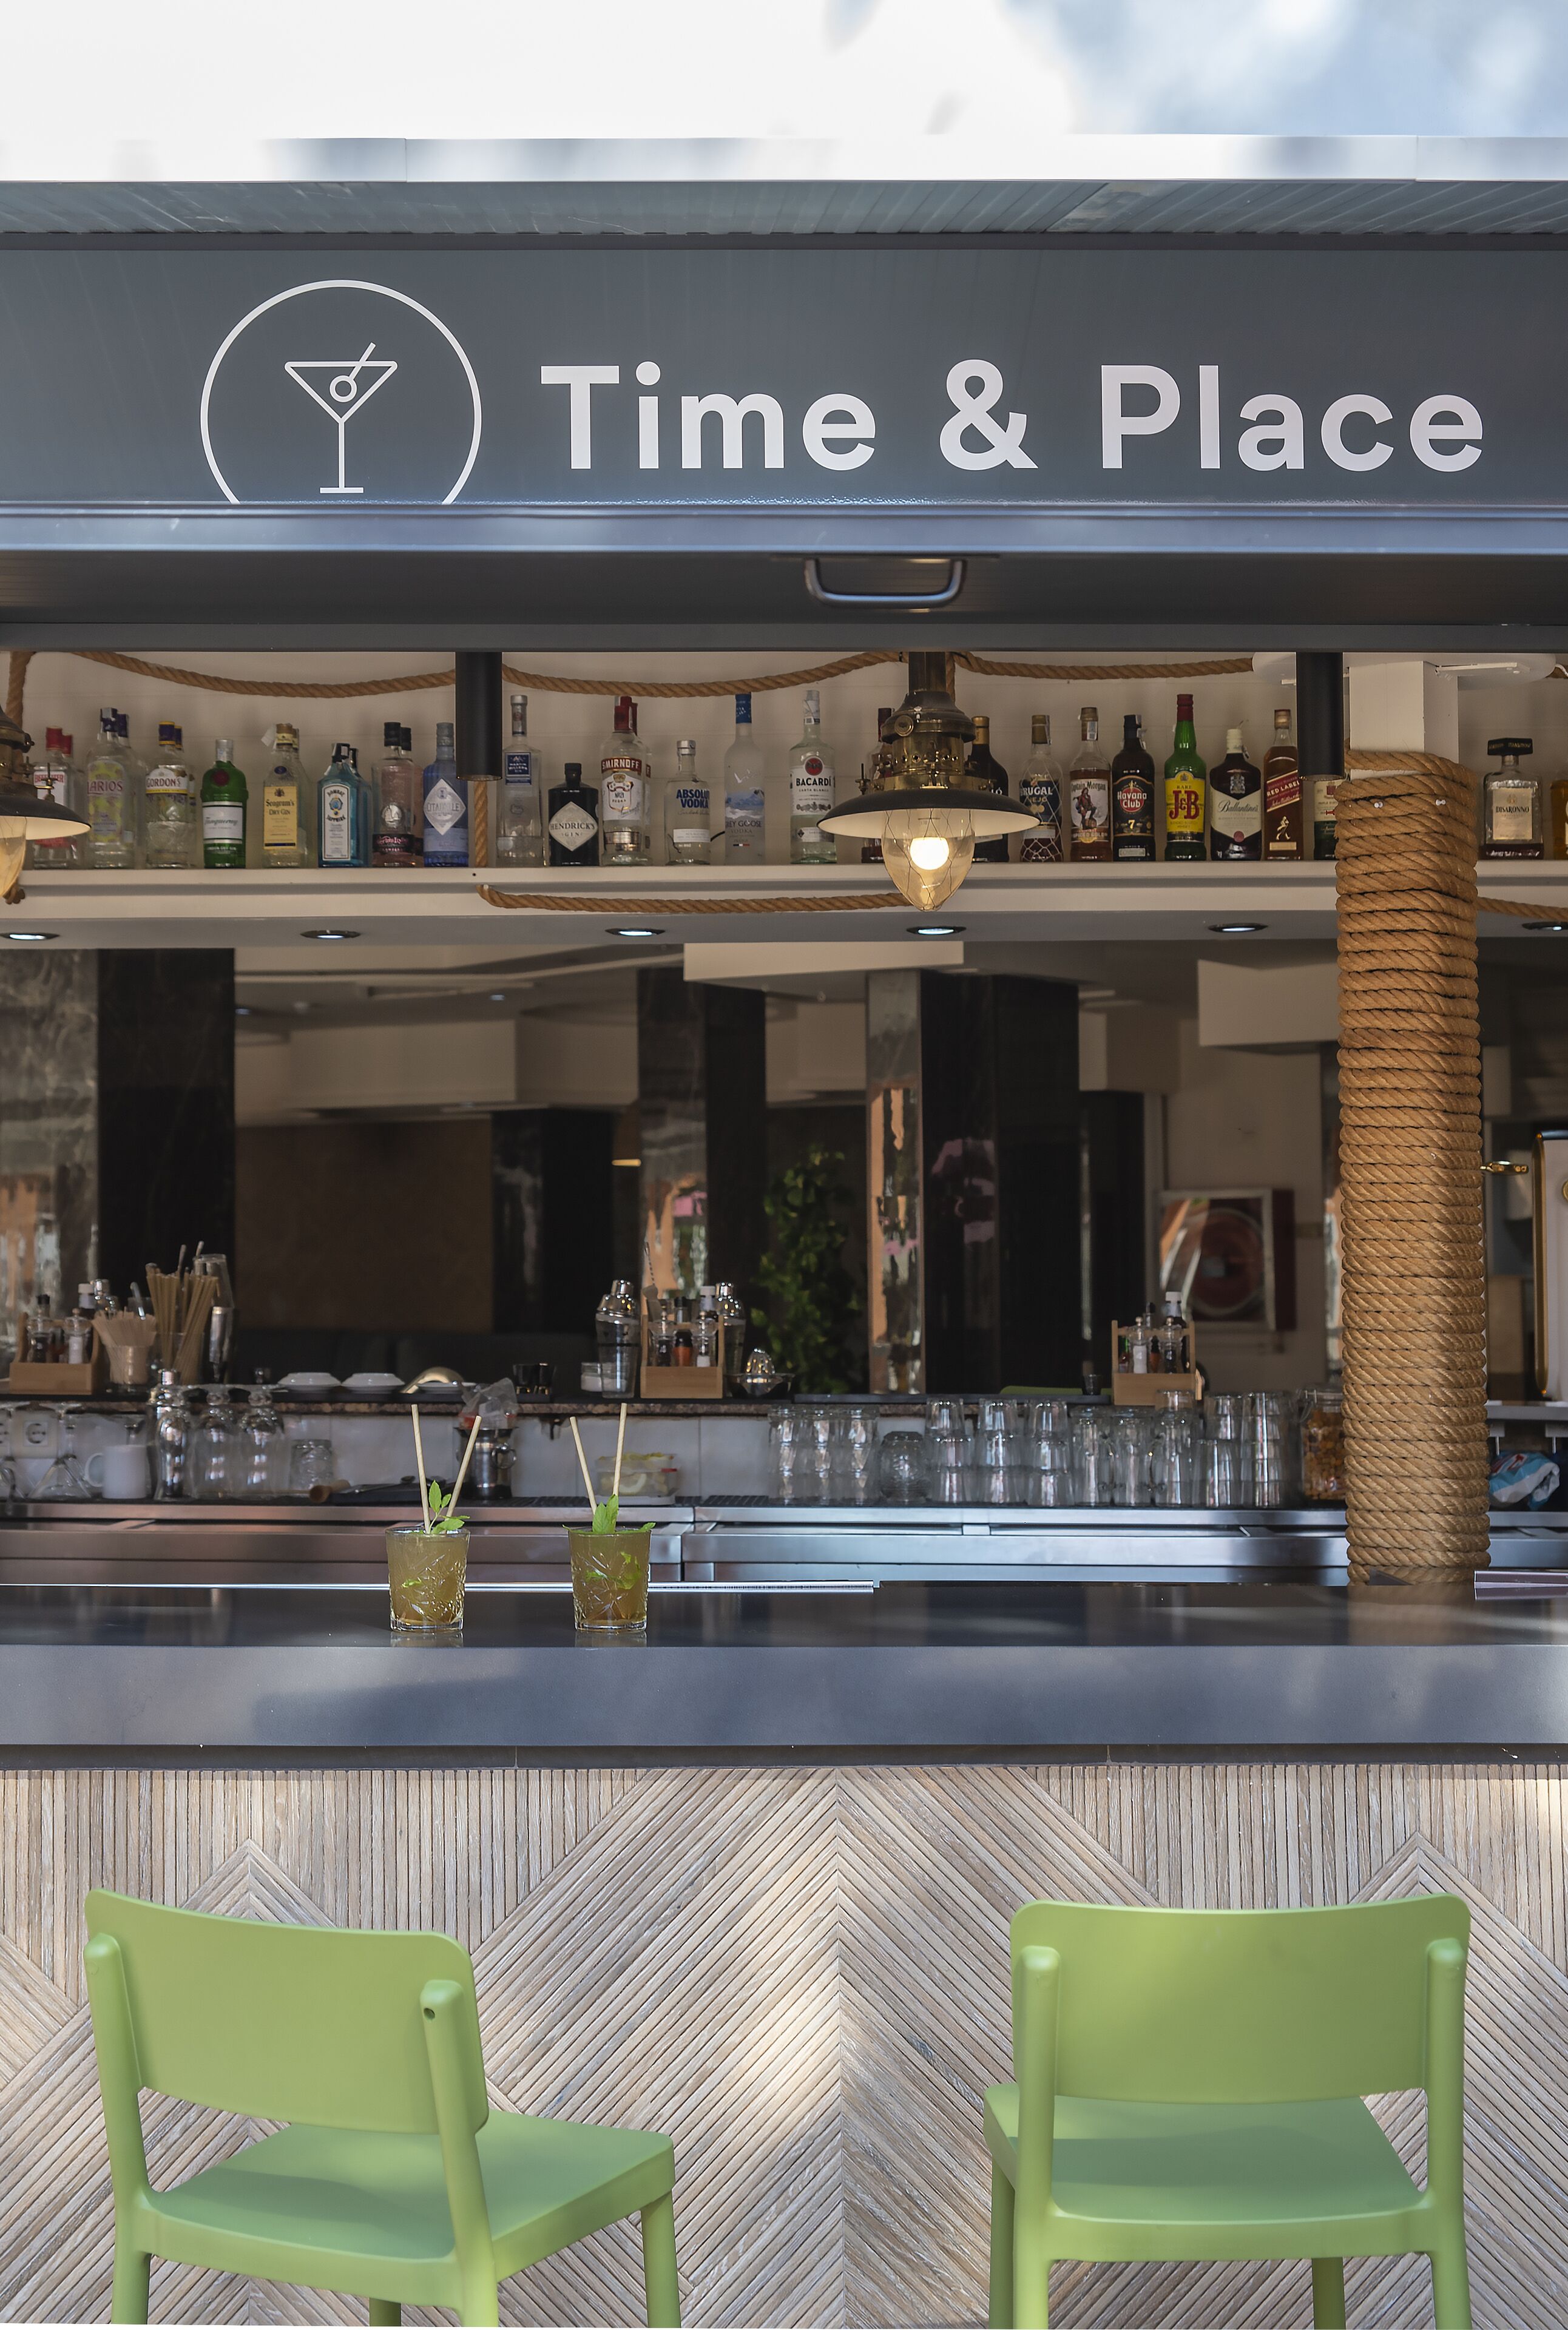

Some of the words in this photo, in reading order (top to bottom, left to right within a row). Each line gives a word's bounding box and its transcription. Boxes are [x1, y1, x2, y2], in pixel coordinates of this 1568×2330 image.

[541, 362, 875, 470] Time
[940, 360, 1038, 470] &
[1101, 365, 1482, 471] Place
[602, 758, 640, 770] SMIRNOFF
[35, 774, 64, 783] BEEFTER
[87, 781, 123, 794] LARIOS
[1019, 786, 1053, 796] BRUGAL
[1087, 781, 1106, 791] Morgan
[1266, 788, 1280, 797] RED
[1280, 780, 1300, 791] LABEL
[1117, 791, 1147, 800] Havana
[266, 799, 294, 808] Seagram's
[427, 802, 460, 811] CITALE
[680, 799, 709, 808] VODKA
[1169, 790, 1200, 819] J&B
[1128, 819, 1135, 829] 7
